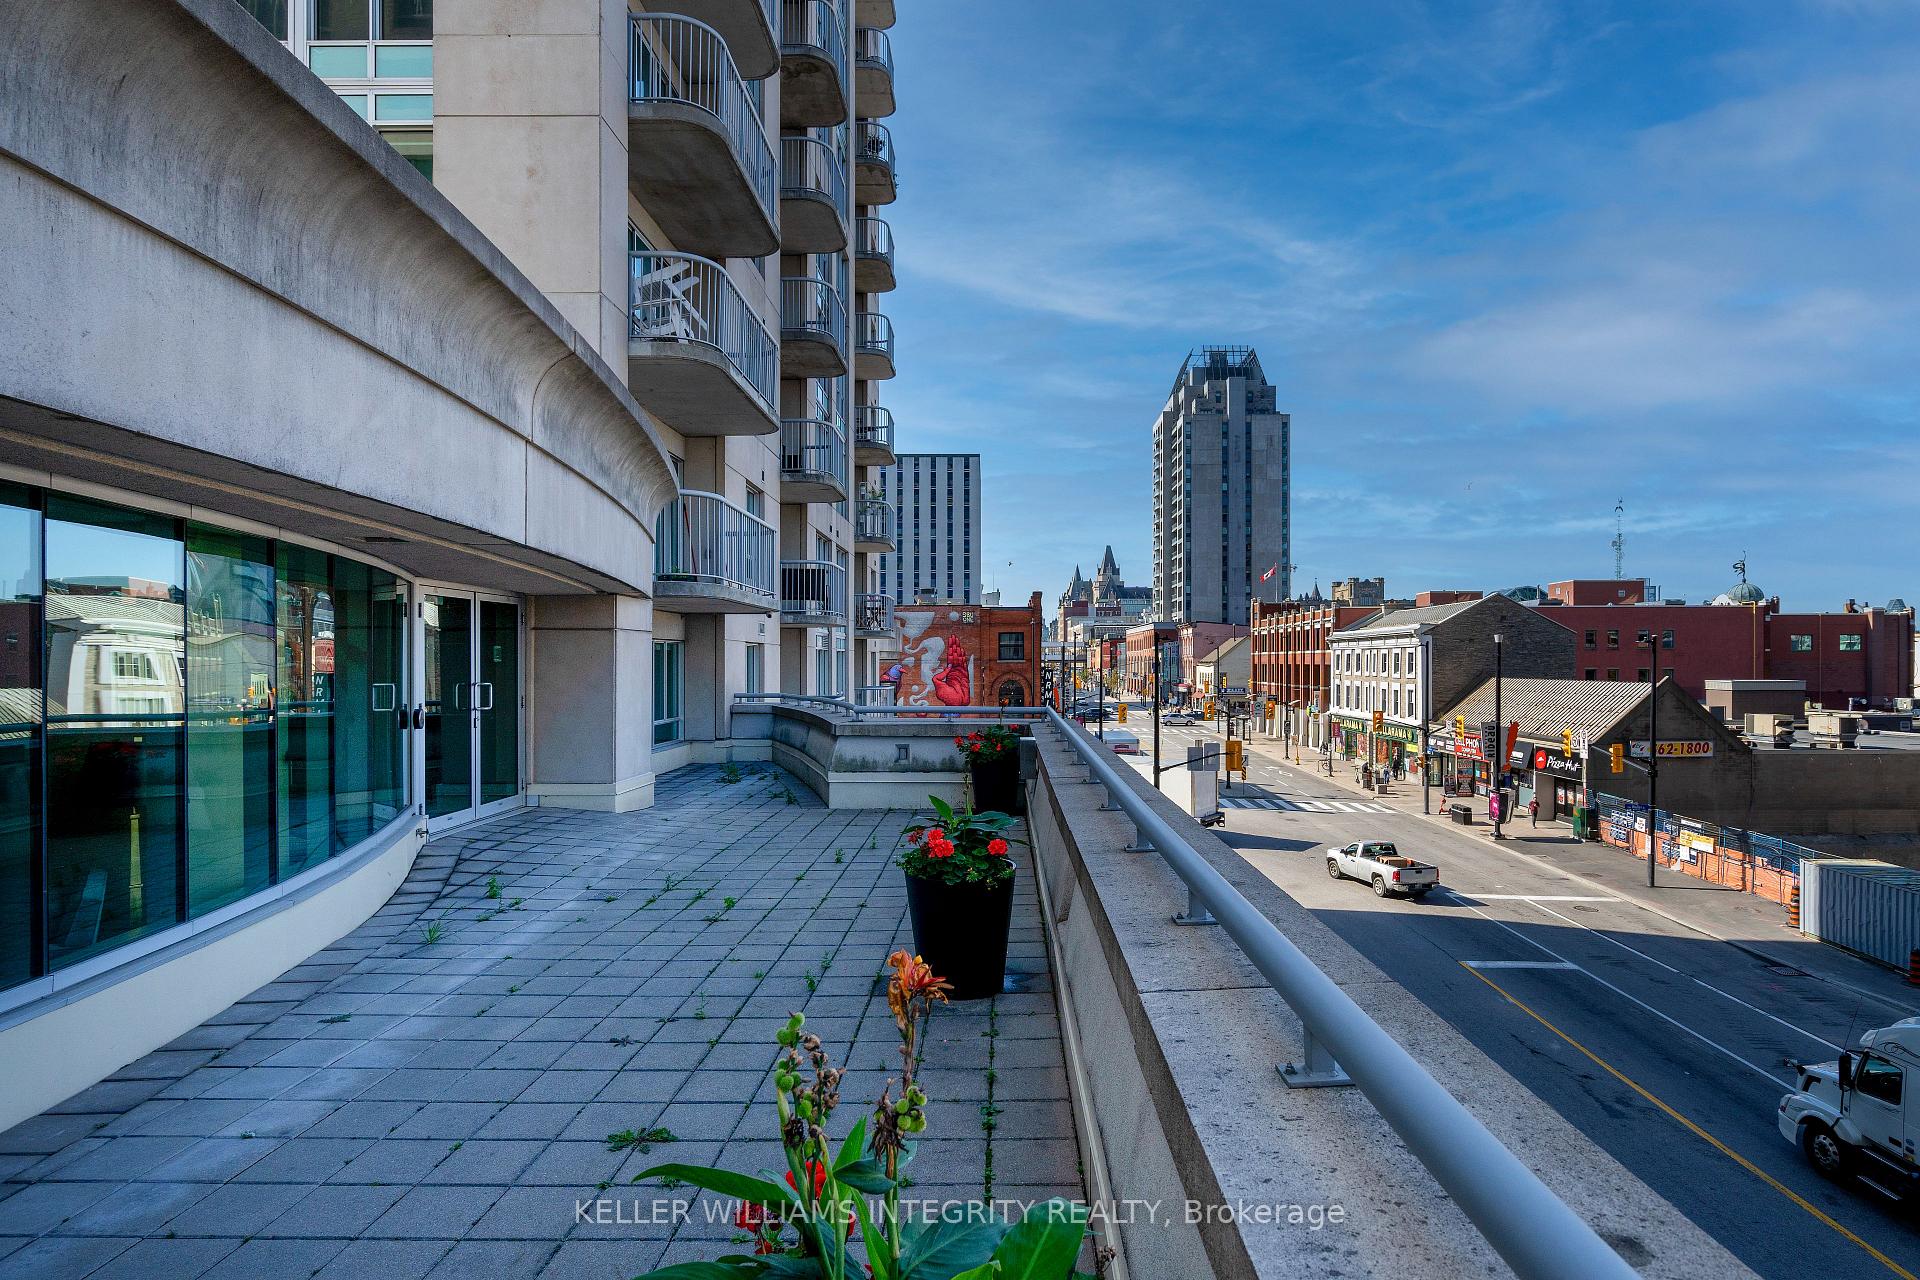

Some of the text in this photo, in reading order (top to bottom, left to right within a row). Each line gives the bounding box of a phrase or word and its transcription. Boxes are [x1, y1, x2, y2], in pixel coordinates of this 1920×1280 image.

[1375, 725, 1407, 739] LLARAMA
[1656, 741, 1710, 755] 62-1800
[1547, 755, 1580, 771] Pizza Hut
